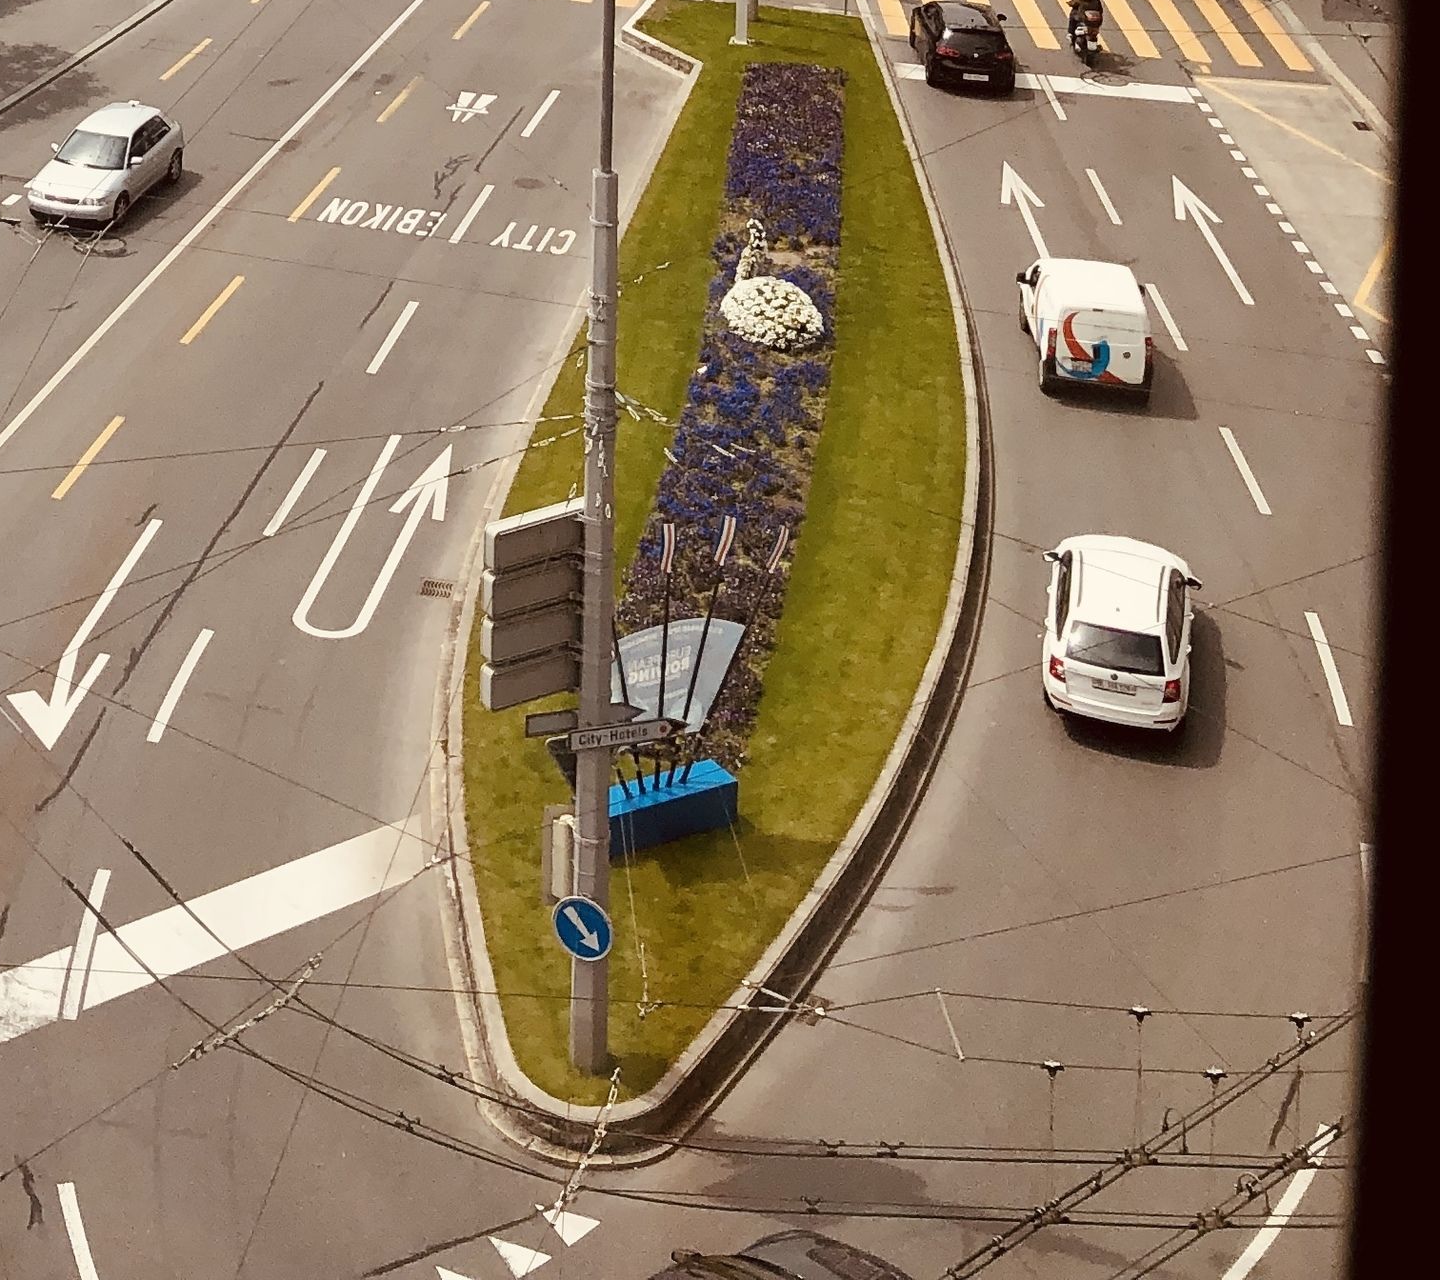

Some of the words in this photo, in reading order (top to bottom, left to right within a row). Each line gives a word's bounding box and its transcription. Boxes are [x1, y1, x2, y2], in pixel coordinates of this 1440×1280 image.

[316, 197, 448, 237] EBIKON
[489, 221, 577, 255] CITY
[578, 726, 648, 745] City-Hotels
